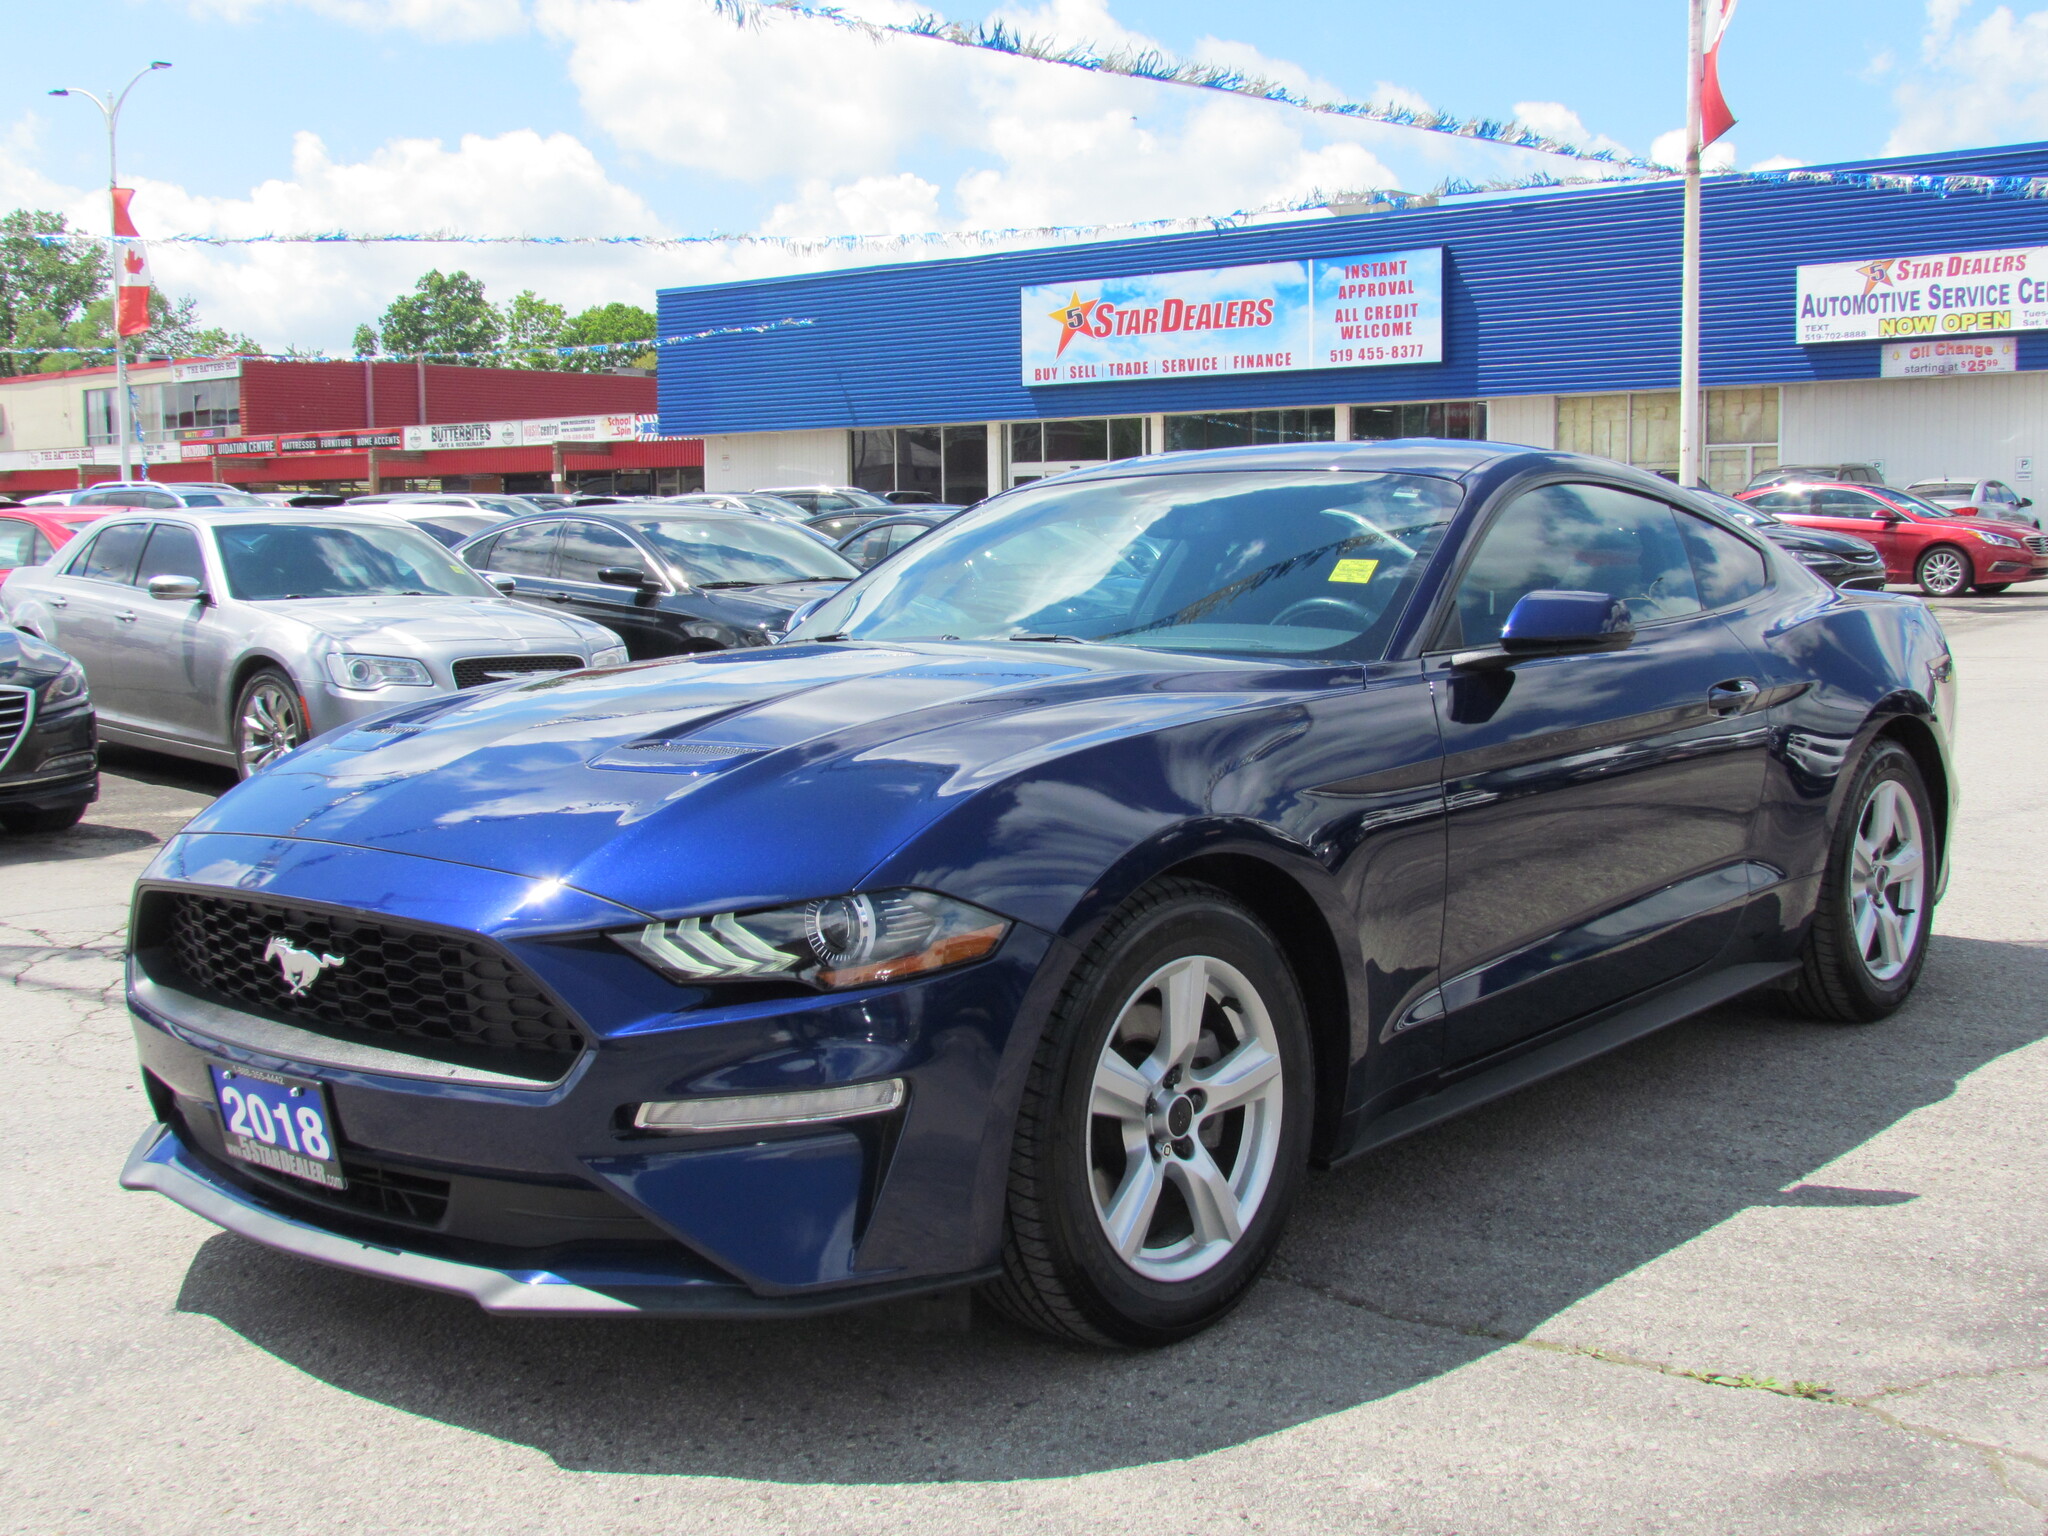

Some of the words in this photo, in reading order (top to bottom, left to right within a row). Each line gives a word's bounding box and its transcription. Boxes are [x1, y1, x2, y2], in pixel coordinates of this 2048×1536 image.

[1345, 260, 1407, 279] INSTANT
[1870, 264, 1885, 281] 5
[1338, 280, 1414, 300] APPROVAL
[1801, 290, 1920, 319] AUTOMOTIVE
[1928, 283, 2010, 310] SERVICE
[2018, 277, 2048, 304] CE
[1066, 308, 1084, 329] 5
[1335, 308, 1359, 323] ALL
[1364, 303, 1418, 321] CREDIT
[1341, 322, 1412, 340] WELCOME
[1805, 324, 1830, 332] TEXT
[1878, 315, 1937, 337] NOW
[1941, 310, 2011, 333] OPEN
[1804, 330, 1867, 341] 519-702-8888
[1330, 348, 1353, 362] 519
[1358, 344, 1423, 360] 455-8377
[1909, 346, 1930, 359] Oil
[1935, 343, 1994, 359] Change
[187, 365, 199, 374] THE
[1034, 367, 1058, 381] BUY
[1070, 365, 1097, 379] SELL
[1109, 361, 1149, 376] TRADE
[1162, 357, 1218, 373] SERVICE
[1233, 352, 1292, 369] FINANCE
[1904, 361, 1946, 374] starting
[1948, 363, 1959, 371] at
[608, 416, 631, 426] School
[431, 423, 491, 442] BUTTERBITES
[248, 440, 275, 452] CENTRE
[282, 440, 317, 450] MATTRESSES
[320, 438, 352, 448] FURNITURE
[357, 437, 373, 446] HOME
[374, 435, 400, 446] ACCENTS
[40, 451, 52, 460] THE
[222, 1086, 330, 1160] 2018
